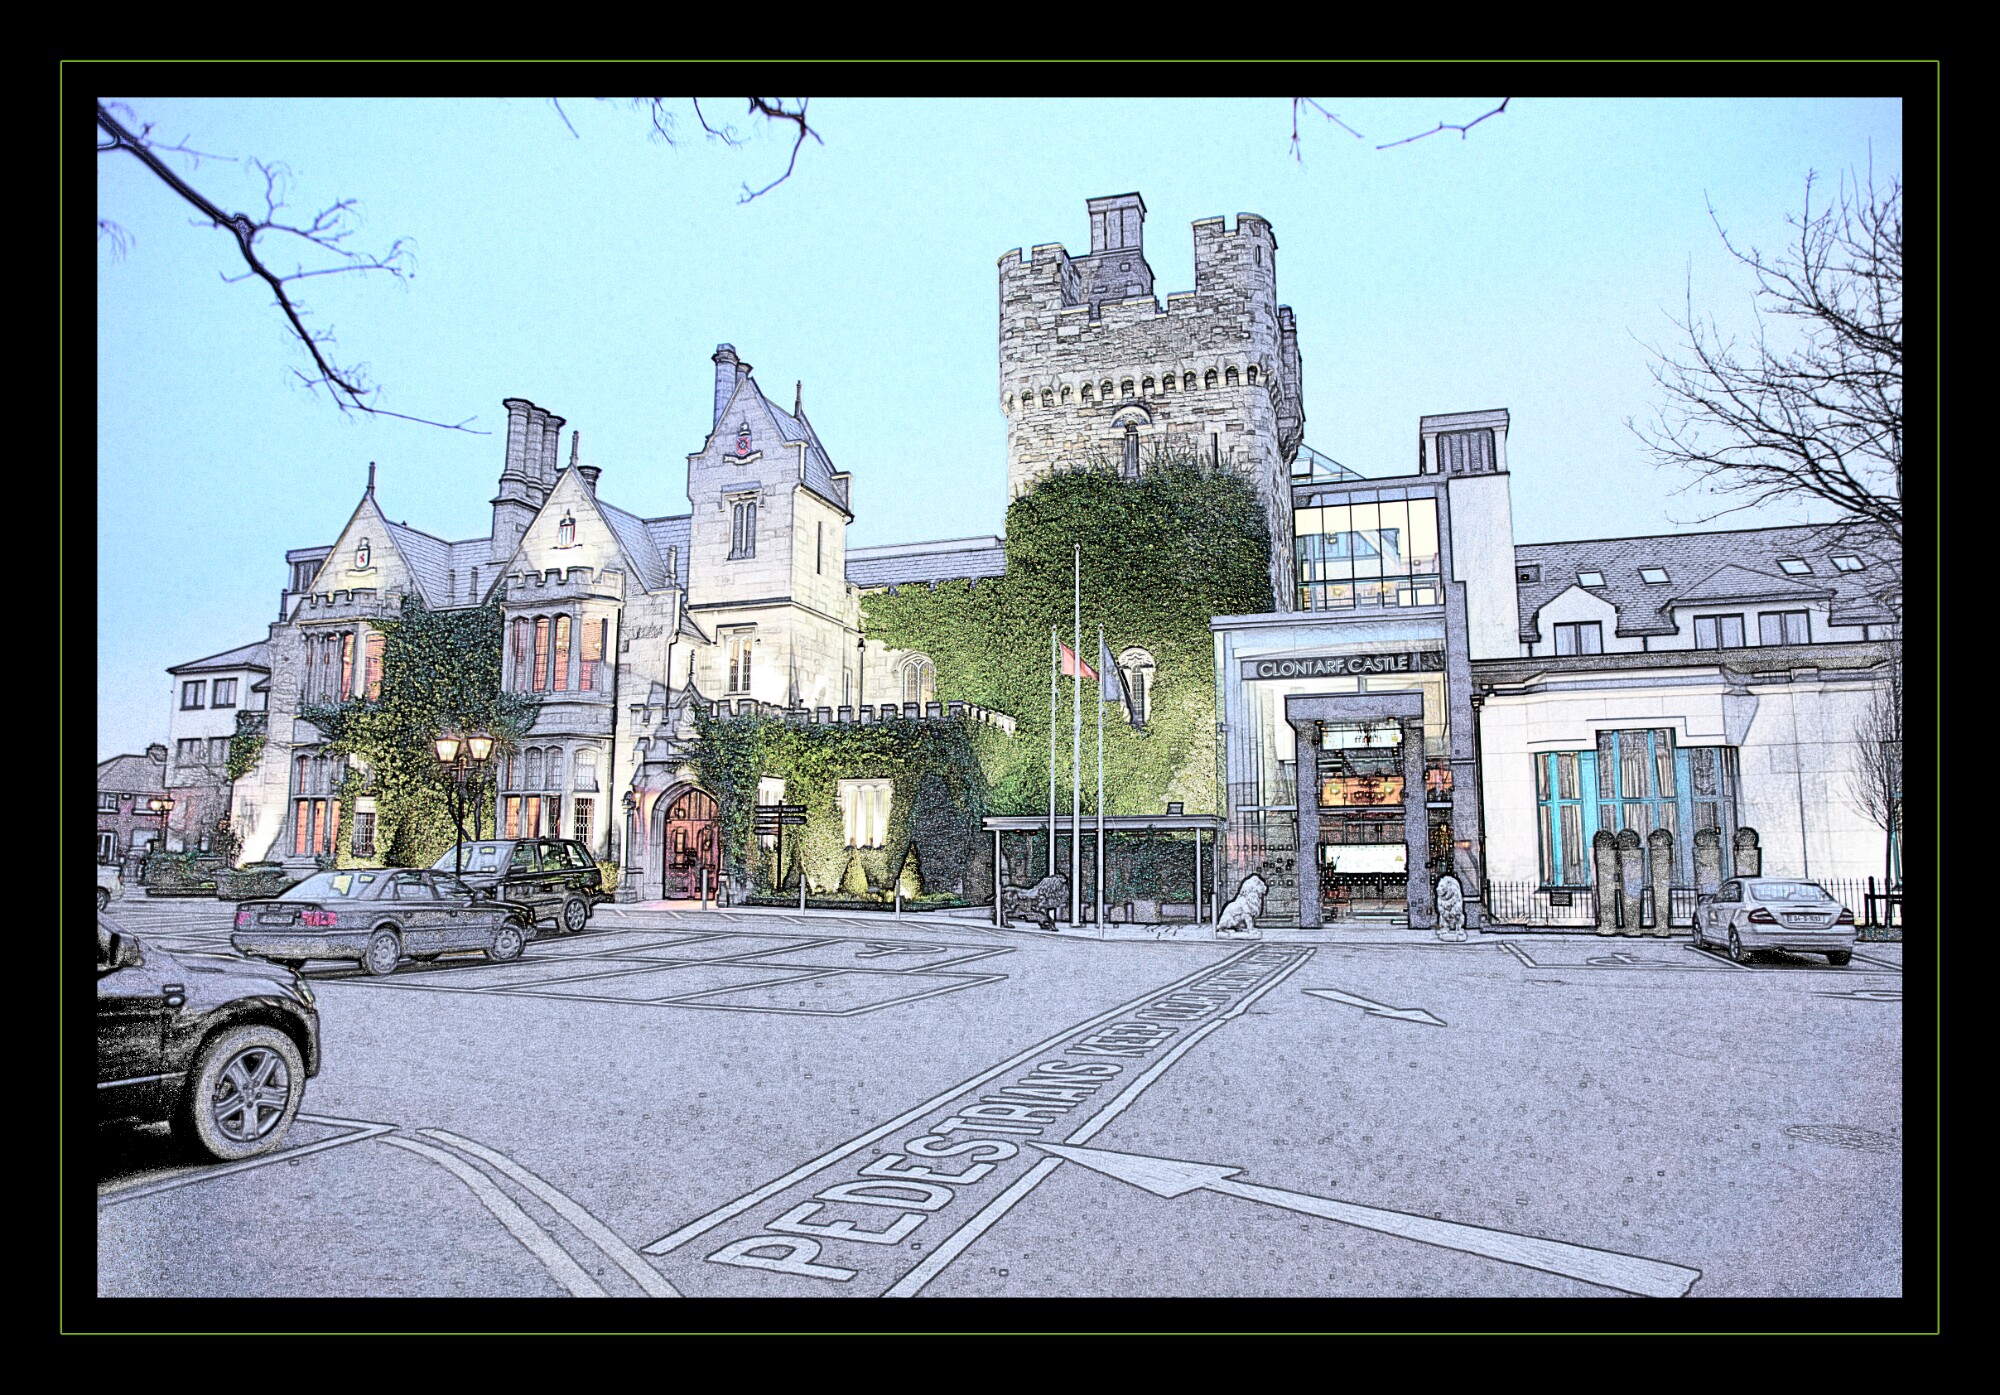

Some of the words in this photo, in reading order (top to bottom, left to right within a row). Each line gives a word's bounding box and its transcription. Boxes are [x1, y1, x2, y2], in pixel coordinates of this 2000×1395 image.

[1258, 658, 1345, 677] CLONTARF
[1348, 655, 1408, 673] CASTLE
[704, 1060, 1124, 1281] PEDESTRIANS
[1065, 1023, 1179, 1057] KEEP
